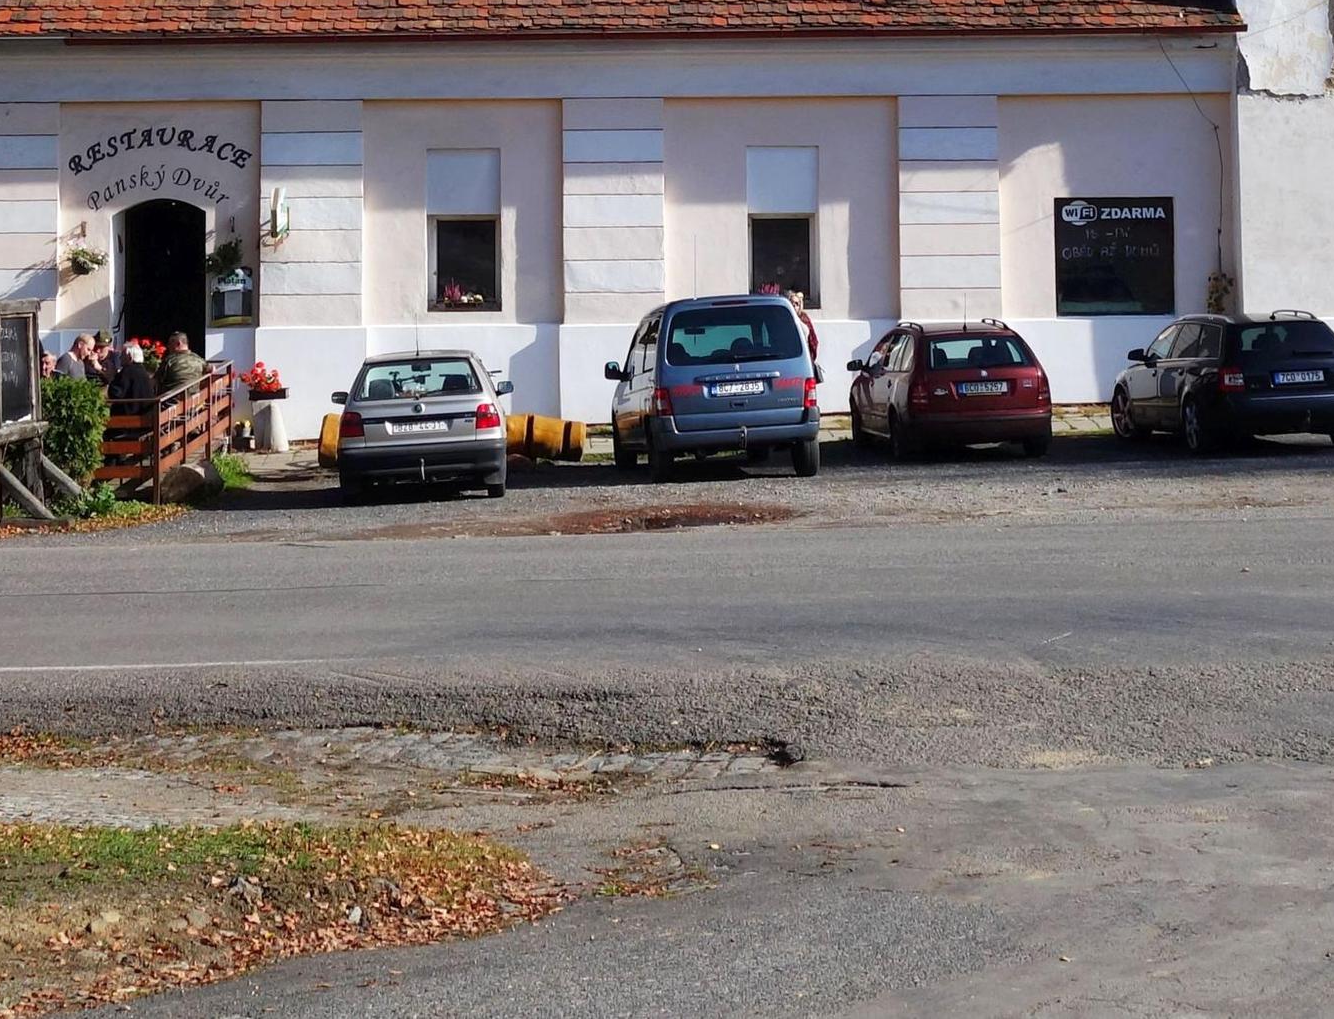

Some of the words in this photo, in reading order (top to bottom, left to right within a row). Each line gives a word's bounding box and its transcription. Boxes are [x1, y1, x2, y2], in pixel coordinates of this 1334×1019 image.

[68, 127, 253, 176] RESTAURACE
[87, 164, 166, 212] Panský
[172, 167, 230, 204] Dvůr
[1100, 207, 1166, 219] ZDARMA
